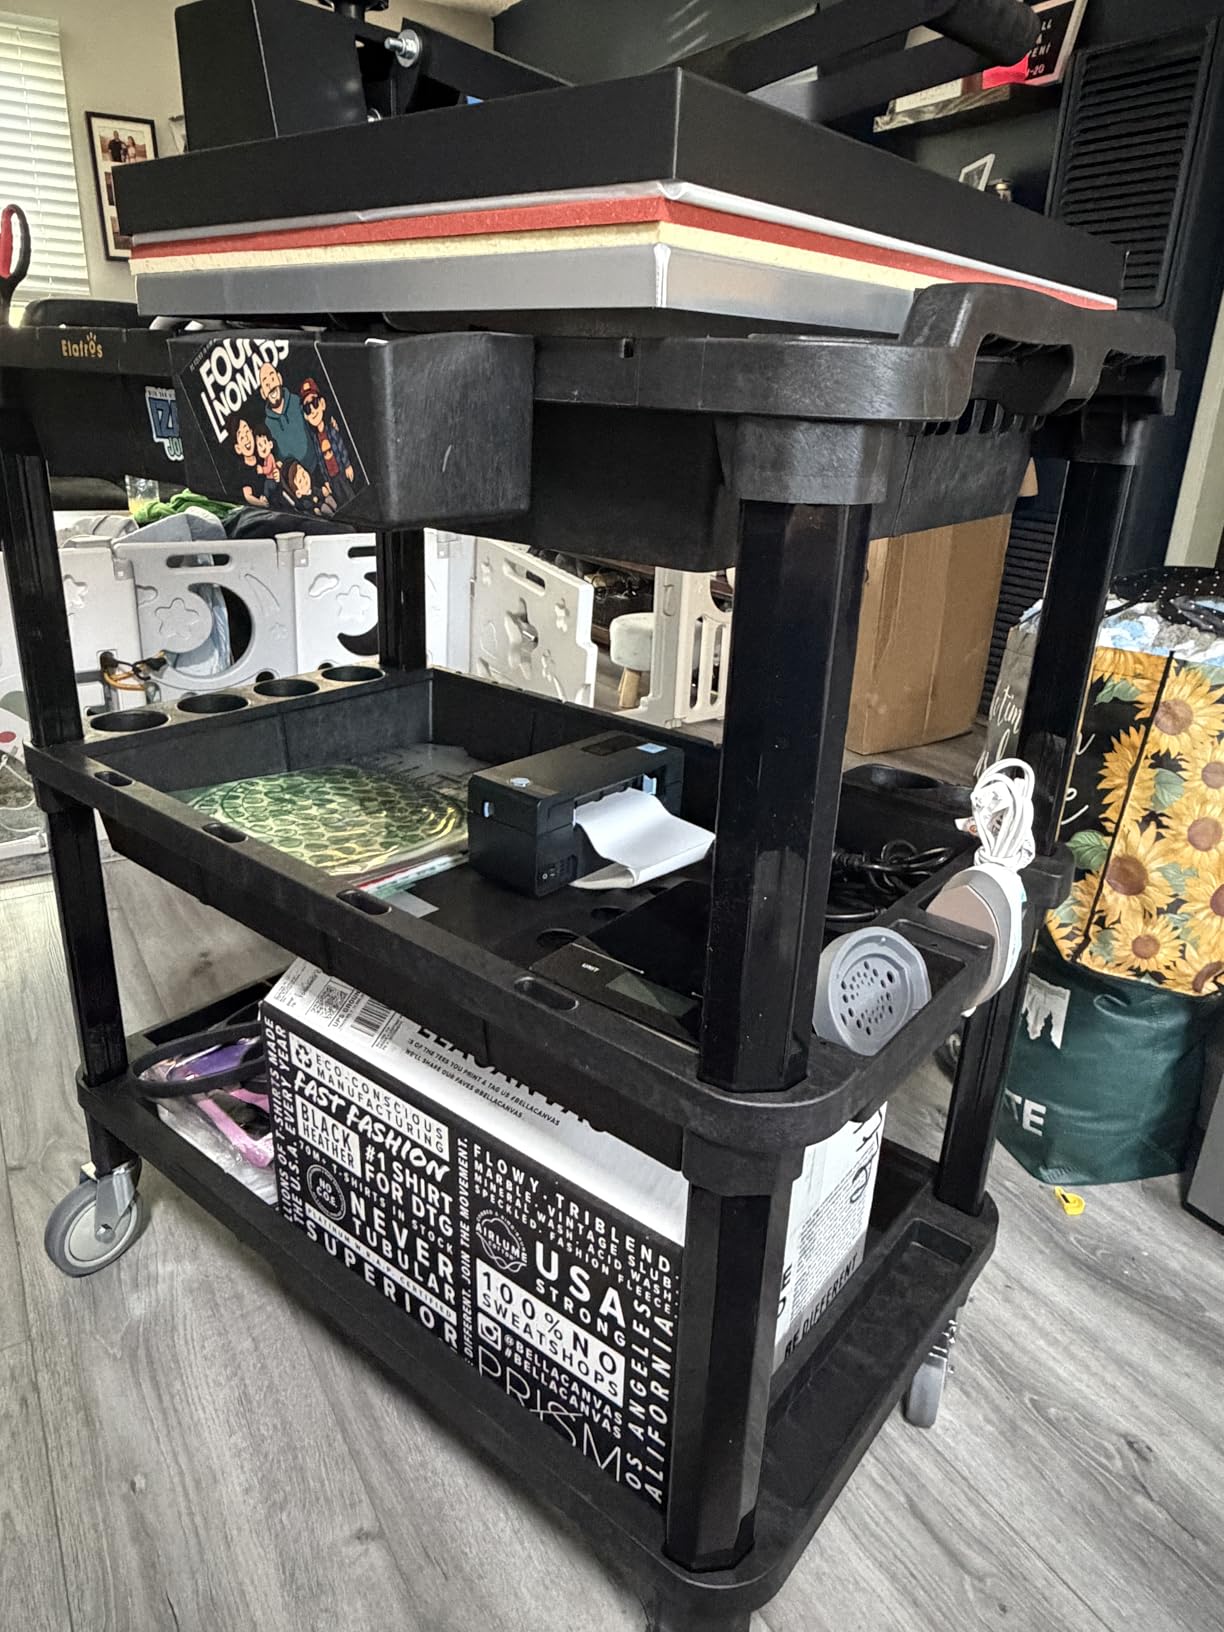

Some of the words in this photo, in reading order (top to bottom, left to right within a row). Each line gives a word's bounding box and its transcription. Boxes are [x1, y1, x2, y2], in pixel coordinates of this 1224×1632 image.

[264, 1015, 278, 1066] MADE
[275, 1024, 290, 1072] YEAR
[270, 1067, 285, 1140] T-SHIRTS
[279, 1075, 296, 1136] EVERY
[294, 1070, 346, 1113] FAST
[346, 1104, 450, 1182] FASHION
[301, 1102, 354, 1154] BLACK
[316, 1054, 443, 1139] ECO-CONSCIOUS
[317, 1067, 444, 1153] MANUFACTURING
[441, 1069, 455, 1080] OUR
[454, 1076, 474, 1091] FAVES
[474, 1087, 523, 1118] @BELLACANVAS
[450, 1060, 464, 1072] YOU
[462, 1068, 483, 1083] PRINT
[487, 1082, 501, 1093] TAG
[500, 1089, 510, 1098] US
[510, 1095, 561, 1126] #BELLACANVAS
[277, 1143, 288, 1166] OF
[287, 1140, 301, 1191] U.S.A.
[302, 1120, 354, 1169] HEATHER
[365, 1144, 386, 1172] #1
[392, 1161, 453, 1215] SHIRT
[457, 1137, 470, 1220] MOVEMENT.
[279, 1169, 293, 1223] LLIONS
[291, 1193, 304, 1225] THE
[332, 1163, 386, 1208] T-SHIRTS
[392, 1205, 405, 1221] IN
[411, 1219, 453, 1255] STOCK
[365, 1162, 403, 1205] FOR
[411, 1193, 454, 1237] DTG
[474, 1172, 529, 1214] MINERAL
[587, 1243, 622, 1270] ACID
[474, 1184, 542, 1233] SPECKLED.
[549, 1231, 609, 1276] FASHION
[547, 1204, 617, 1256] VINTAGE
[350, 1190, 454, 1285] NEVER
[352, 1217, 455, 1305] TUBULAR
[460, 1220, 470, 1248] THE
[461, 1250, 471, 1285] JOIN
[475, 1222, 528, 1263] AIRLUME
[305, 1220, 457, 1349] SUPERIOR
[535, 1240, 626, 1329] USA
[535, 1278, 626, 1347] STRONG
[461, 1288, 473, 1359] DIFFERENT.
[482, 1271, 563, 1341] 100%
[572, 1330, 617, 1376] NO
[482, 1292, 618, 1397] SWEATSHOPS
[503, 1333, 623, 1425] @BELLACANVAS
[504, 1347, 622, 1440] #BELLACANVAS
[628, 1298, 651, 1441] ANGELES
[644, 1315, 674, 1505] ALIFORNIA
[624, 1452, 643, 1490] OS
